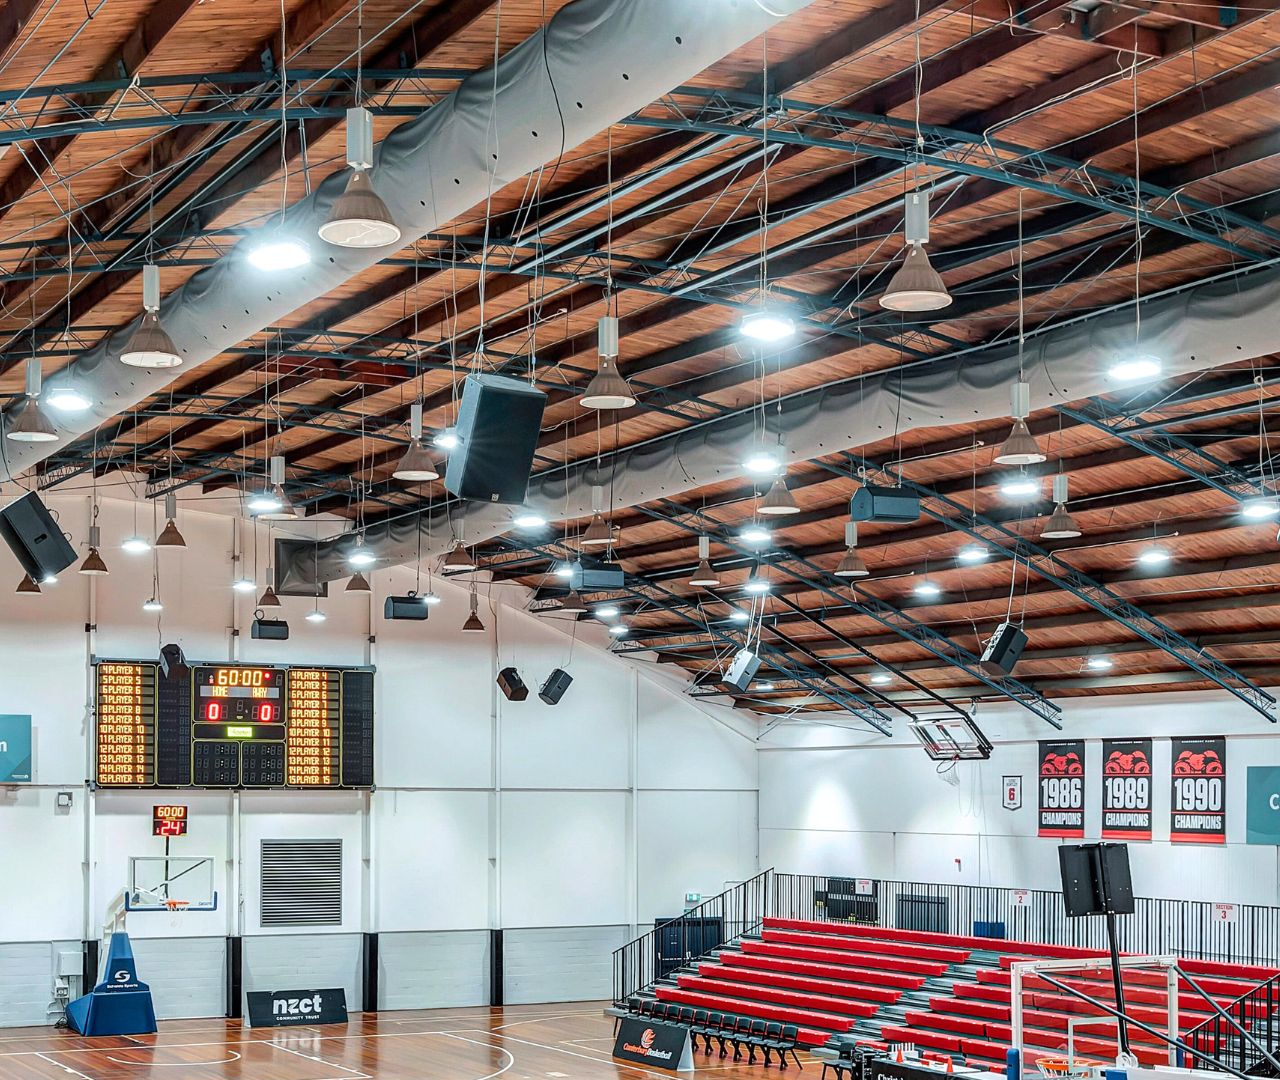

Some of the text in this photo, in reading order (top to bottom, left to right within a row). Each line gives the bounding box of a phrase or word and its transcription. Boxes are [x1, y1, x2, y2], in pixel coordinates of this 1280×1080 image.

[218, 670, 262, 686] 60:00
[212, 686, 228, 696] HOME
[253, 688, 267, 698] AWAY
[208, 703, 219, 720] 0
[261, 705, 271, 721] 0
[1009, 788, 1015, 801] 6
[1041, 778, 1082, 808] 1986
[1106, 778, 1148, 809] 1989
[1175, 778, 1221, 811] 1990
[1042, 812, 1082, 825] CHAMPIONS
[1106, 813, 1148, 827] CHAMPIONS
[1175, 815, 1221, 829] CHAMPIONS
[161, 821, 180, 835] 24
[1222, 911, 1226, 919] 3
[273, 994, 322, 1015] nzct
